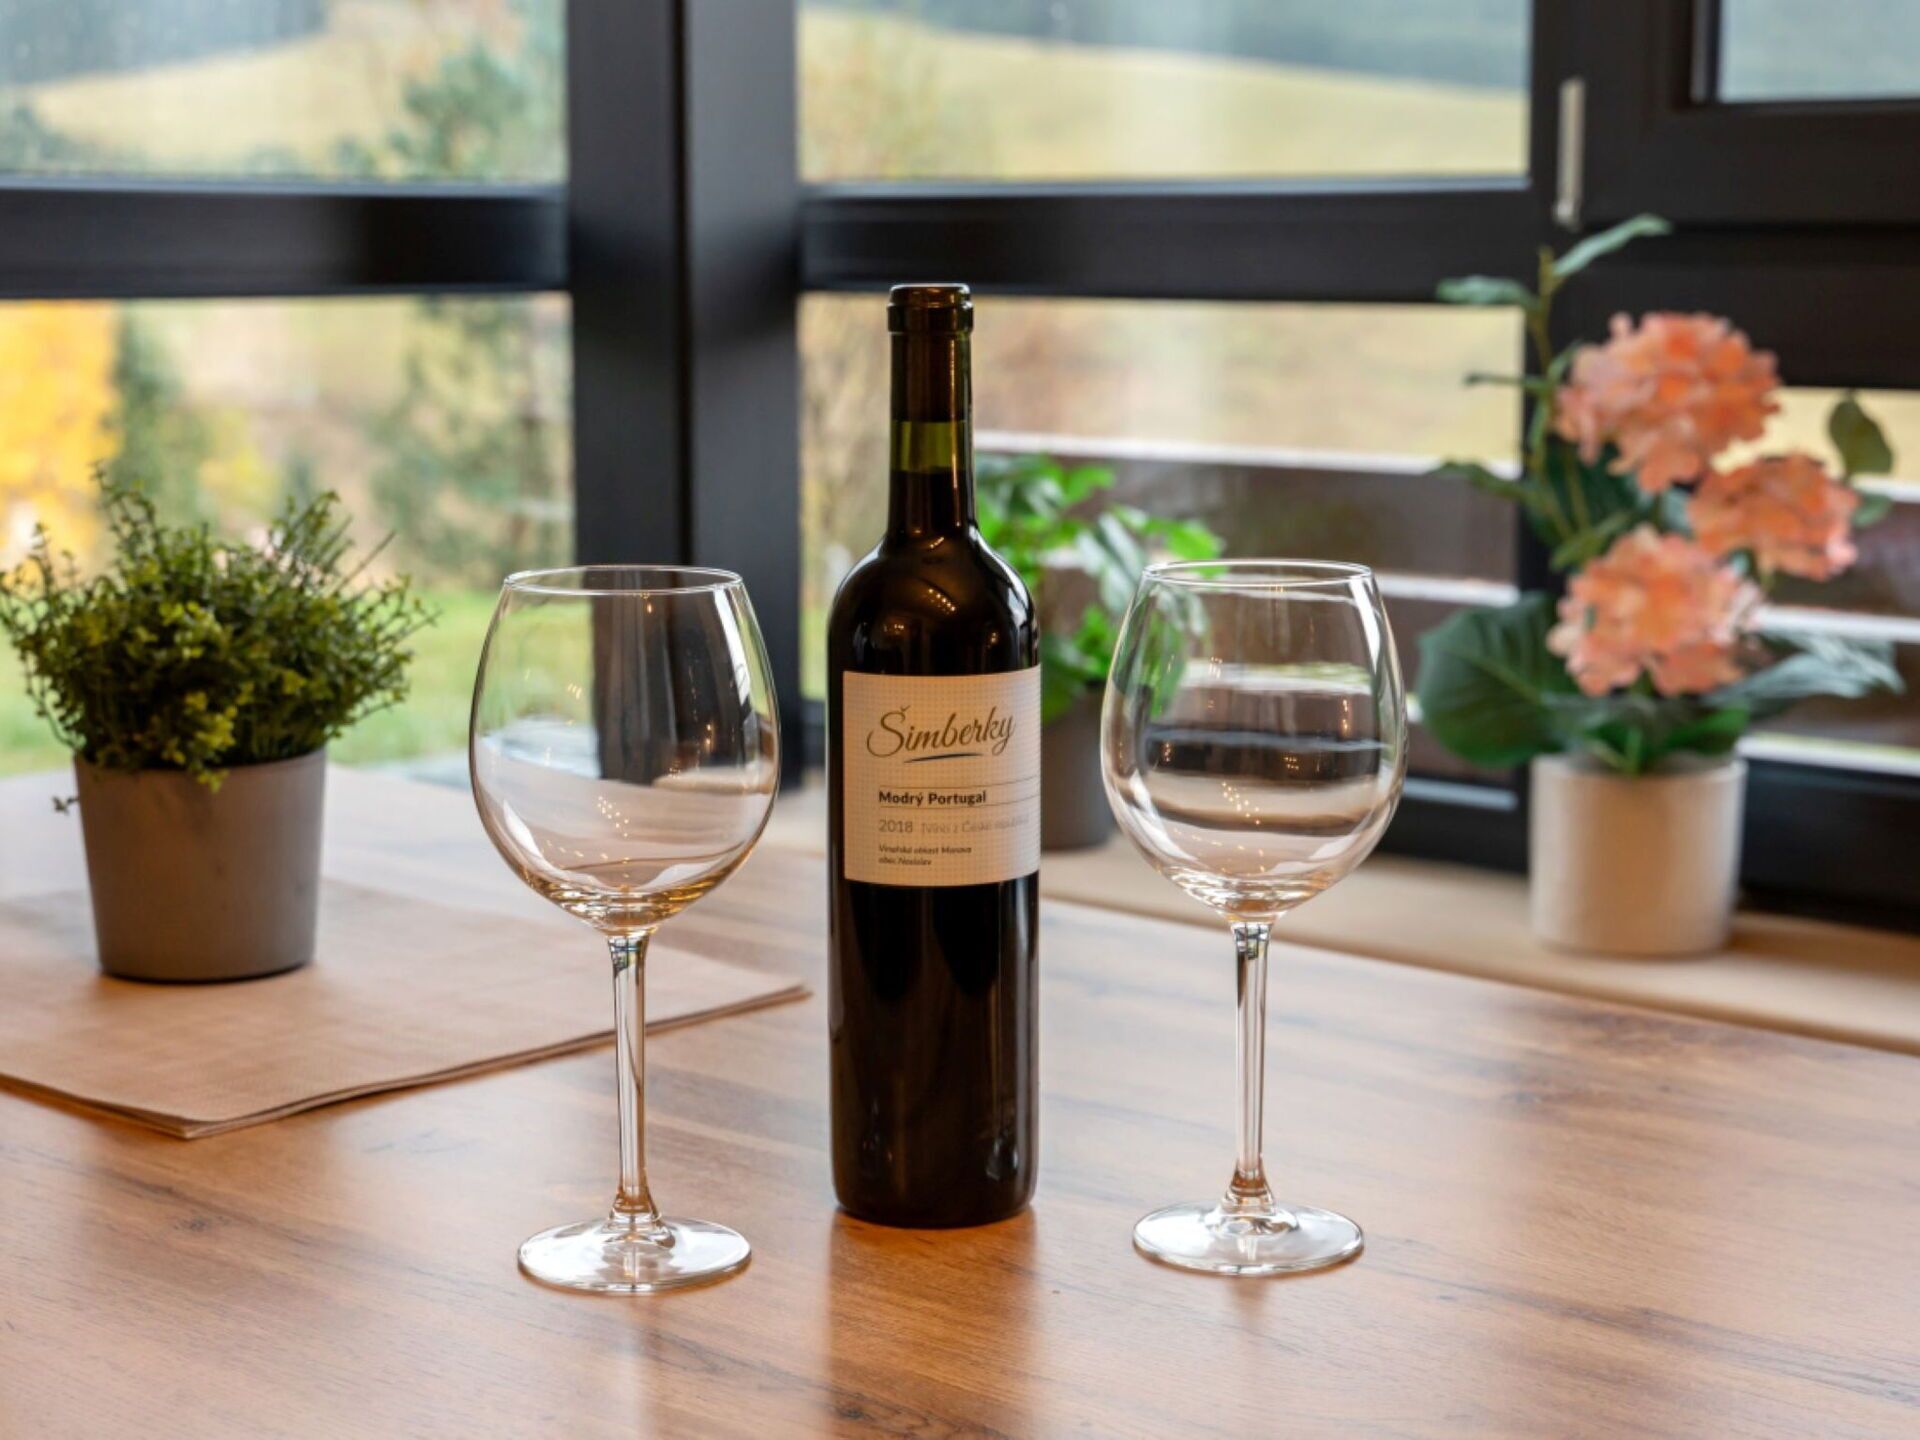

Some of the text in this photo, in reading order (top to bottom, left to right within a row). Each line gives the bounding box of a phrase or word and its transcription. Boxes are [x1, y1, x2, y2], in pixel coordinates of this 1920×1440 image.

[866, 705, 1016, 758] Šimberky
[879, 790, 986, 807] Modrý Portugal
[878, 819, 914, 834] 2018
